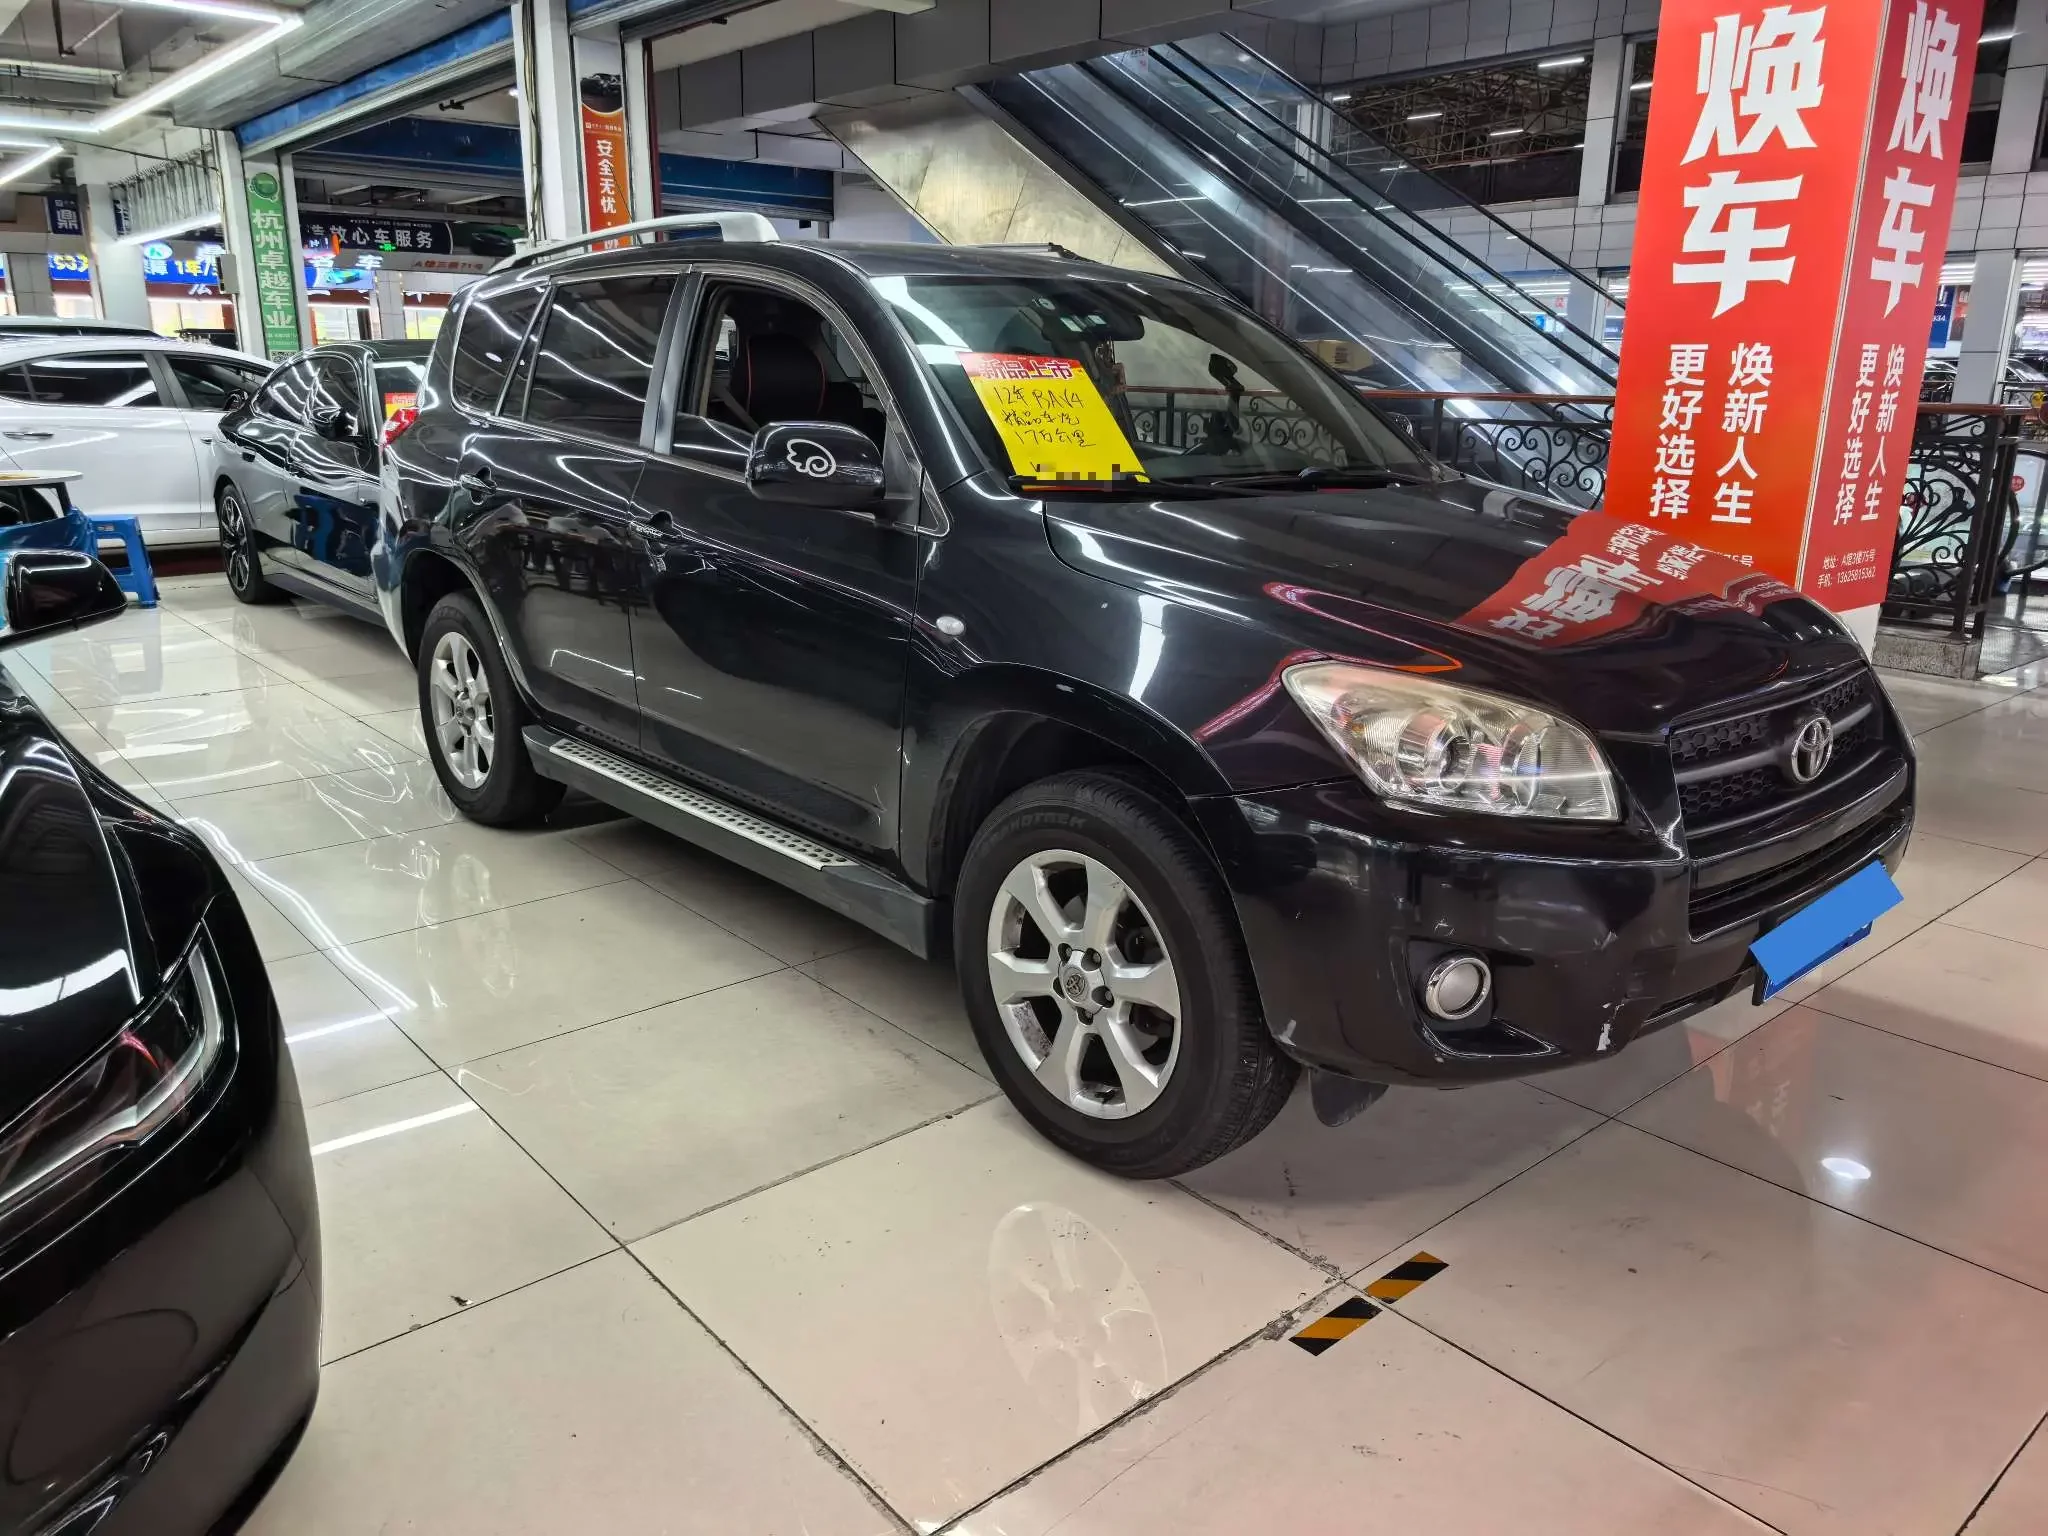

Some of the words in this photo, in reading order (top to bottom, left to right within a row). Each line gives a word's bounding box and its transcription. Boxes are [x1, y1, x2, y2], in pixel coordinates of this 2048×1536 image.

[596, 139, 617, 214] 安全无忧
[1672, 4, 1828, 319] 焕车
[1871, 1, 1960, 319] 焕车
[251, 208, 296, 329] 杭州卓越车业
[980, 359, 1073, 380] 新品上市
[1650, 343, 1708, 520] 更好选择
[1711, 342, 1774, 524] 焕新人生
[1835, 343, 1881, 526] 更好选择
[1861, 343, 1905, 523] 焕新人生
